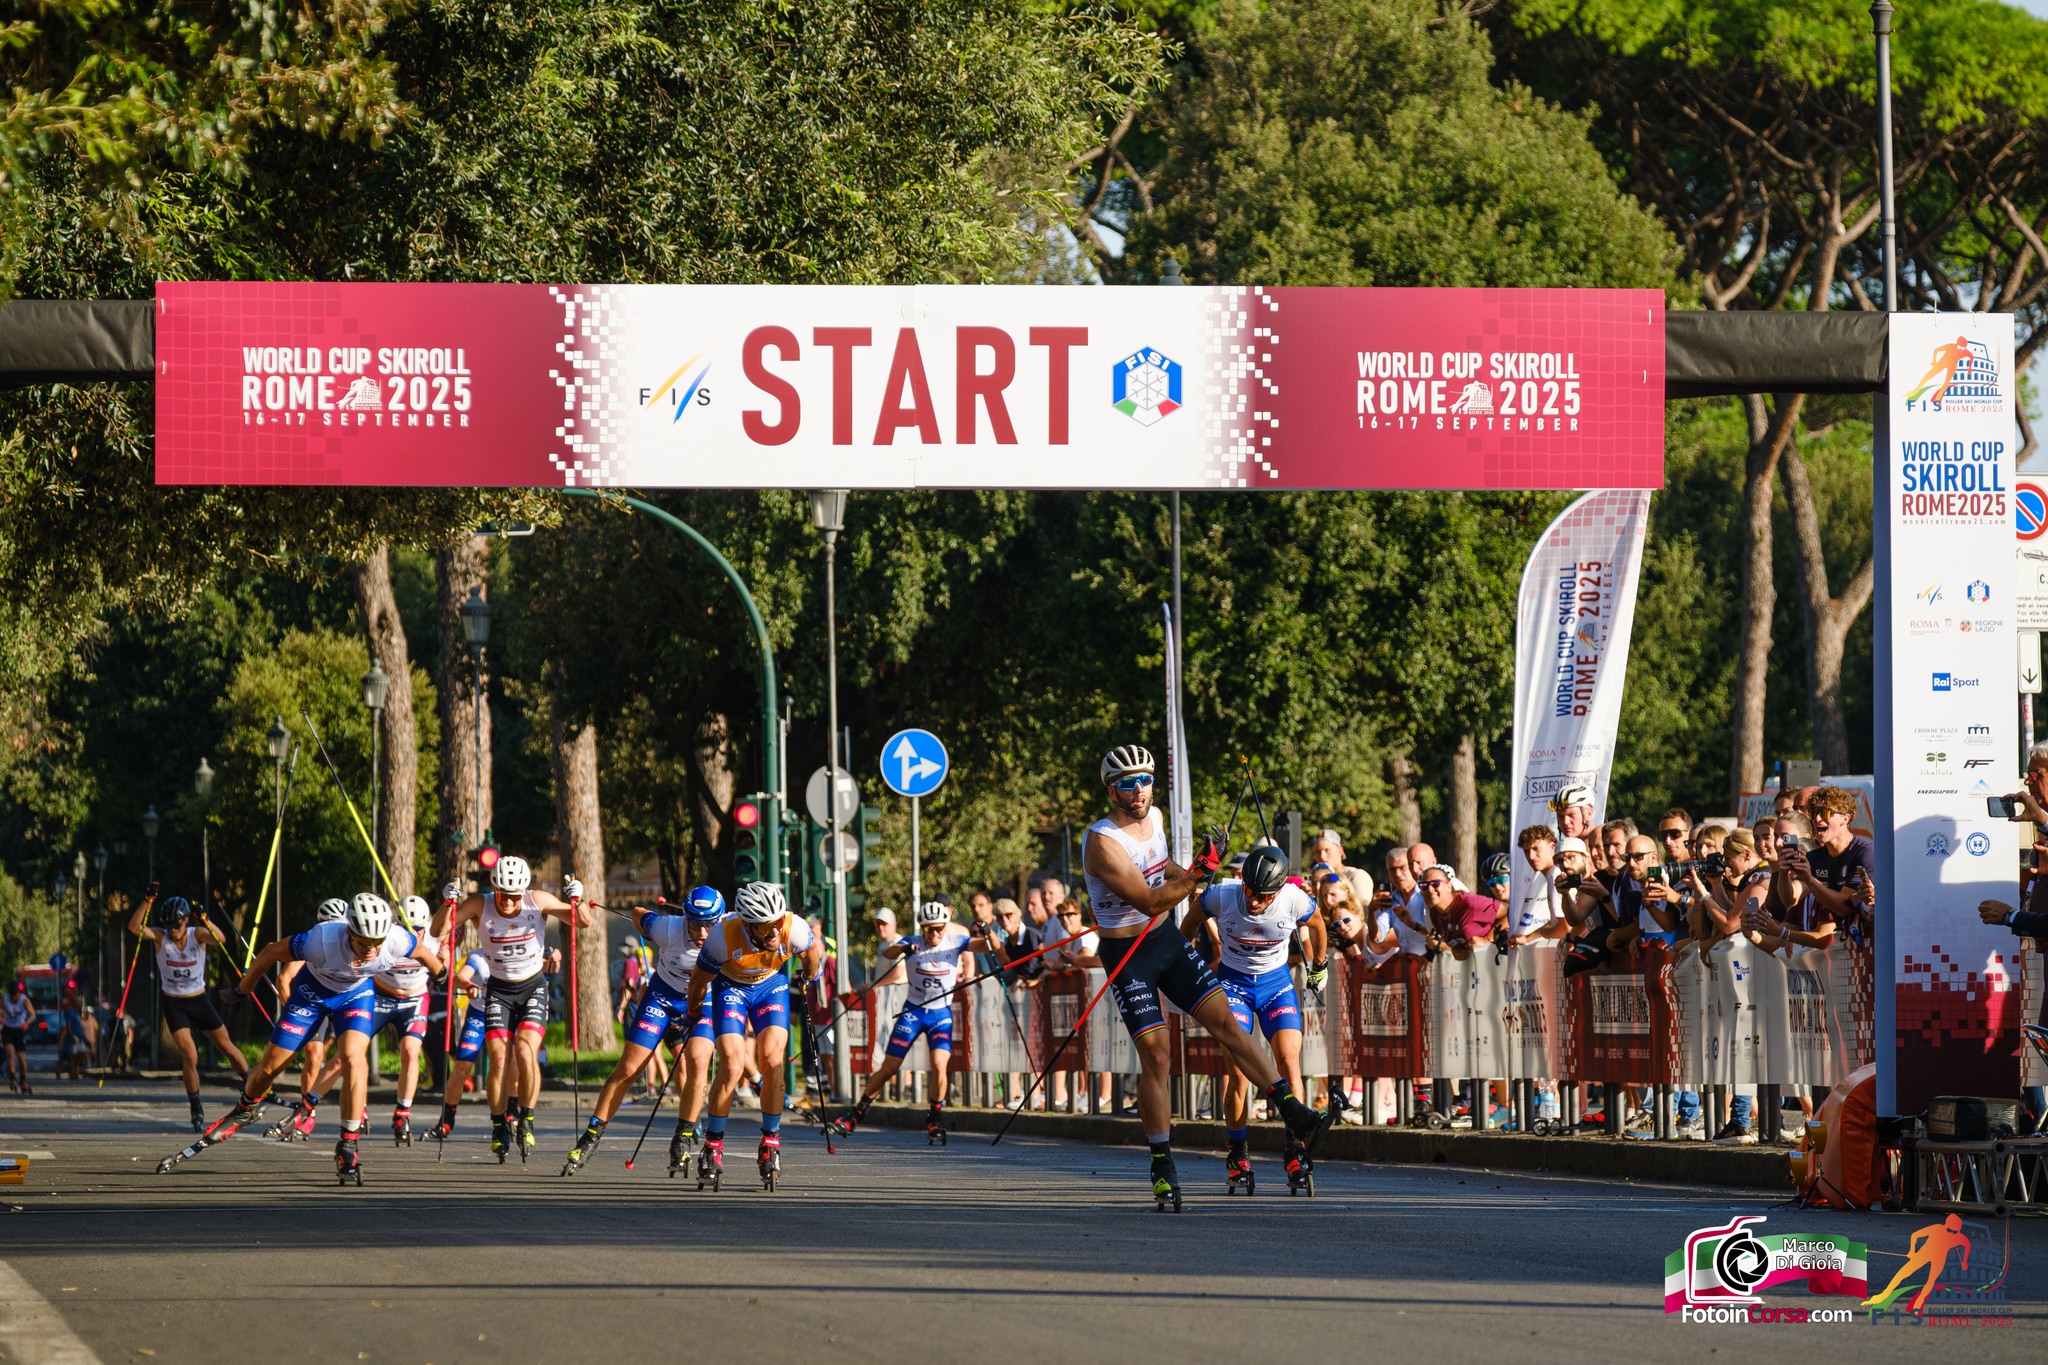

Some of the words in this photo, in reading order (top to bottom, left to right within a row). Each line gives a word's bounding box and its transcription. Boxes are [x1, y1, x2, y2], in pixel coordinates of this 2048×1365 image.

[242, 347, 322, 374] WORLD
[328, 347, 371, 374] CUP
[378, 347, 470, 374] SKIROLL
[1125, 351, 1170, 370] FISI
[1357, 352, 1434, 378] WORLD
[1441, 352, 1482, 379] CUP
[1490, 352, 1580, 379] SKIROLL
[742, 325, 1089, 446] START
[242, 375, 336, 411] ROME
[388, 376, 471, 412] 2025
[639, 387, 711, 407] FIS
[1357, 380, 1447, 414] ROME
[1500, 381, 1580, 415] 2025
[1907, 399, 1942, 412] FIS
[243, 412, 305, 425] 16-17
[323, 412, 470, 427] SEPTEMBER
[1358, 416, 1418, 429] 16-17
[1436, 416, 1578, 431] SEPTEMBER
[1902, 441, 1964, 461] WORLD
[1971, 441, 2005, 461] CUP
[1902, 463, 2006, 492] SKIROLL
[1902, 493, 2006, 516] ROME2025
[1559, 563, 1577, 626] SKIROLL
[1578, 561, 1602, 618] 2025
[1910, 620, 1940, 628] ROMA
[1558, 631, 1575, 659] CUP
[1934, 677, 1950, 686] Rai
[1952, 678, 1979, 687] Sport
[1556, 665, 1574, 717] WORLD
[1529, 749, 1557, 758] ROMA
[503, 944, 527, 957] 55
[173, 969, 191, 978] 63
[922, 978, 942, 988] 65
[1128, 992, 1152, 1002] TAKU
[347, 1011, 369, 1020] enel
[1271, 1007, 1294, 1018] enel
[281, 1023, 302, 1035] enel
[639, 1022, 659, 1034] enel
